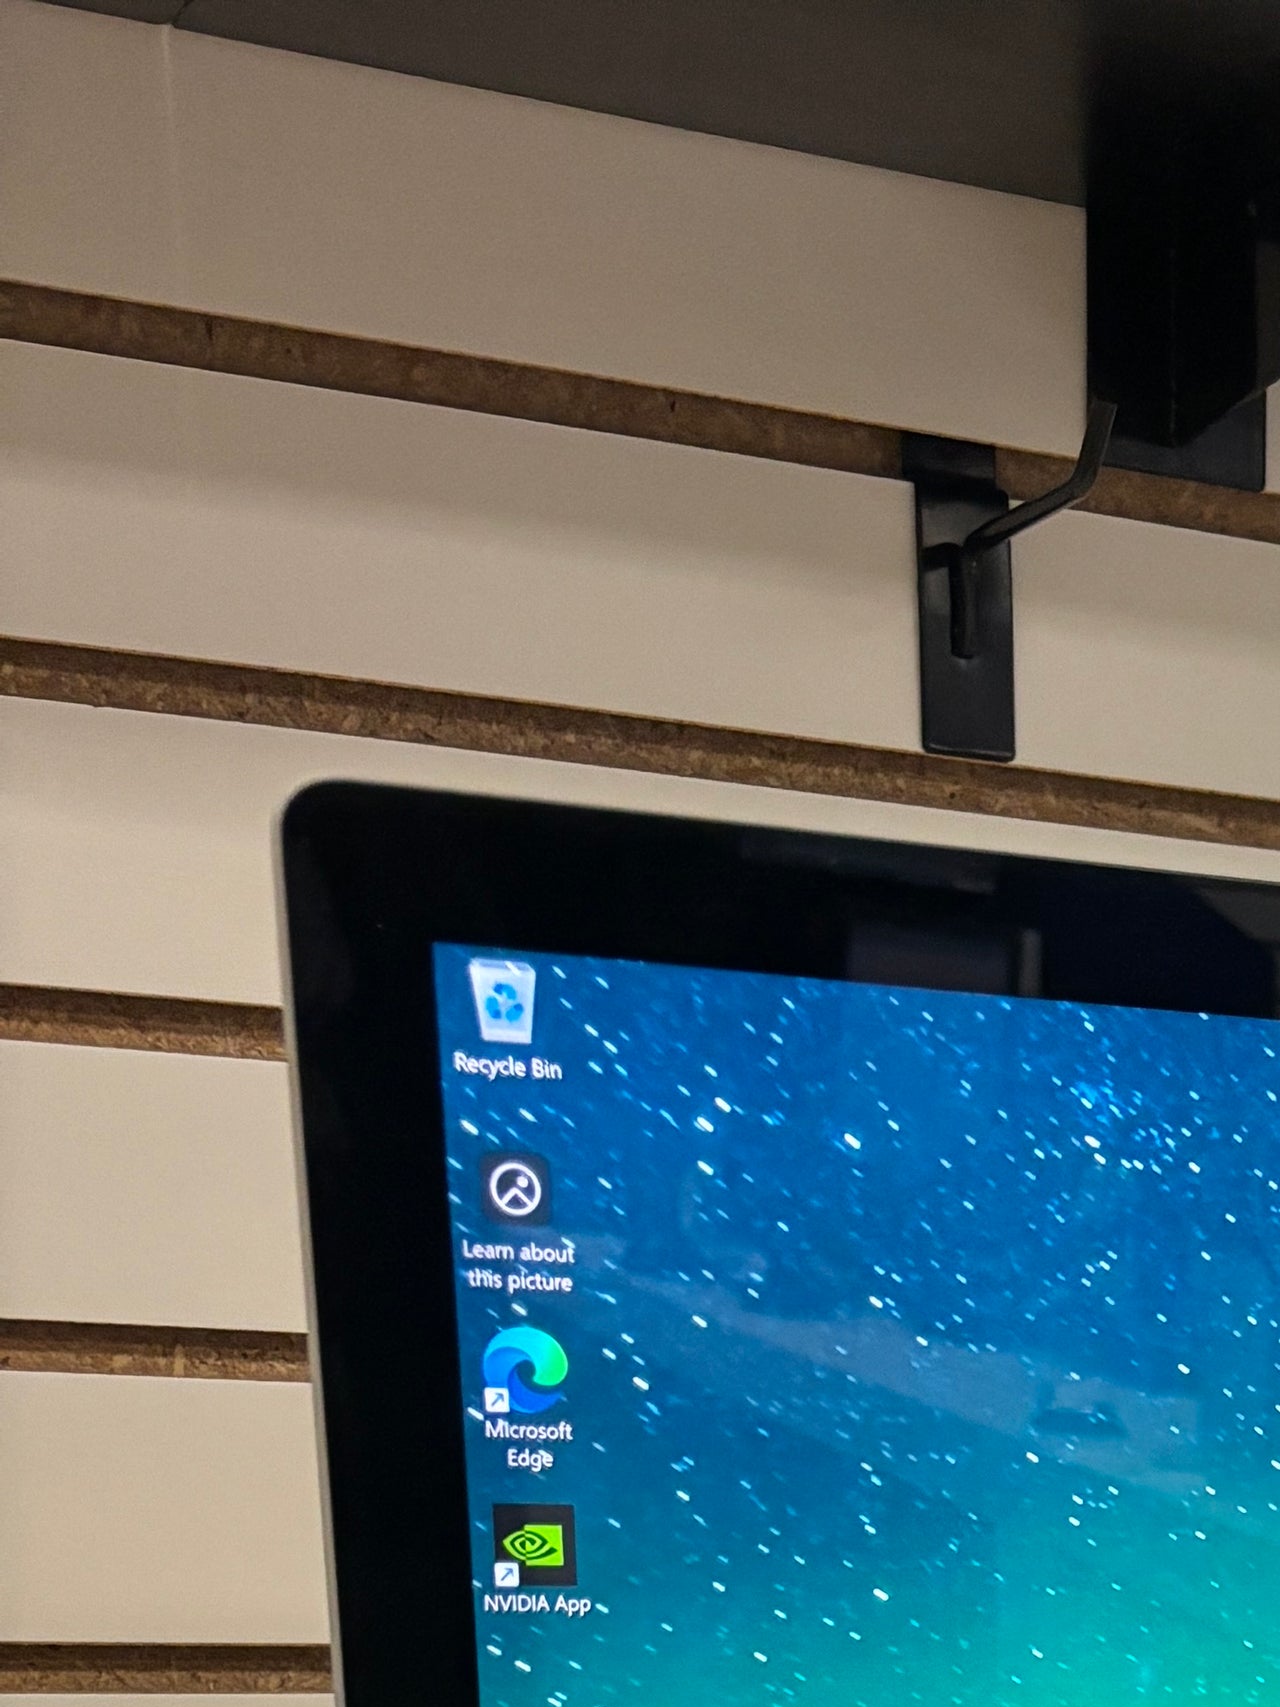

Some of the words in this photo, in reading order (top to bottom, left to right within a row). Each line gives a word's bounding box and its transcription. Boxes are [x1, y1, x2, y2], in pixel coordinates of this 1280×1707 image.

[453, 1051, 527, 1081] Recycle
[530, 1057, 563, 1080] Bin
[462, 1239, 514, 1261] Learn
[519, 1242, 575, 1264] about
[467, 1267, 503, 1290] this
[507, 1271, 574, 1295] picture
[484, 1419, 574, 1441] Microsoft
[507, 1448, 554, 1472] Edge
[484, 1594, 550, 1614] NVIDIA
[553, 1595, 592, 1617] App
